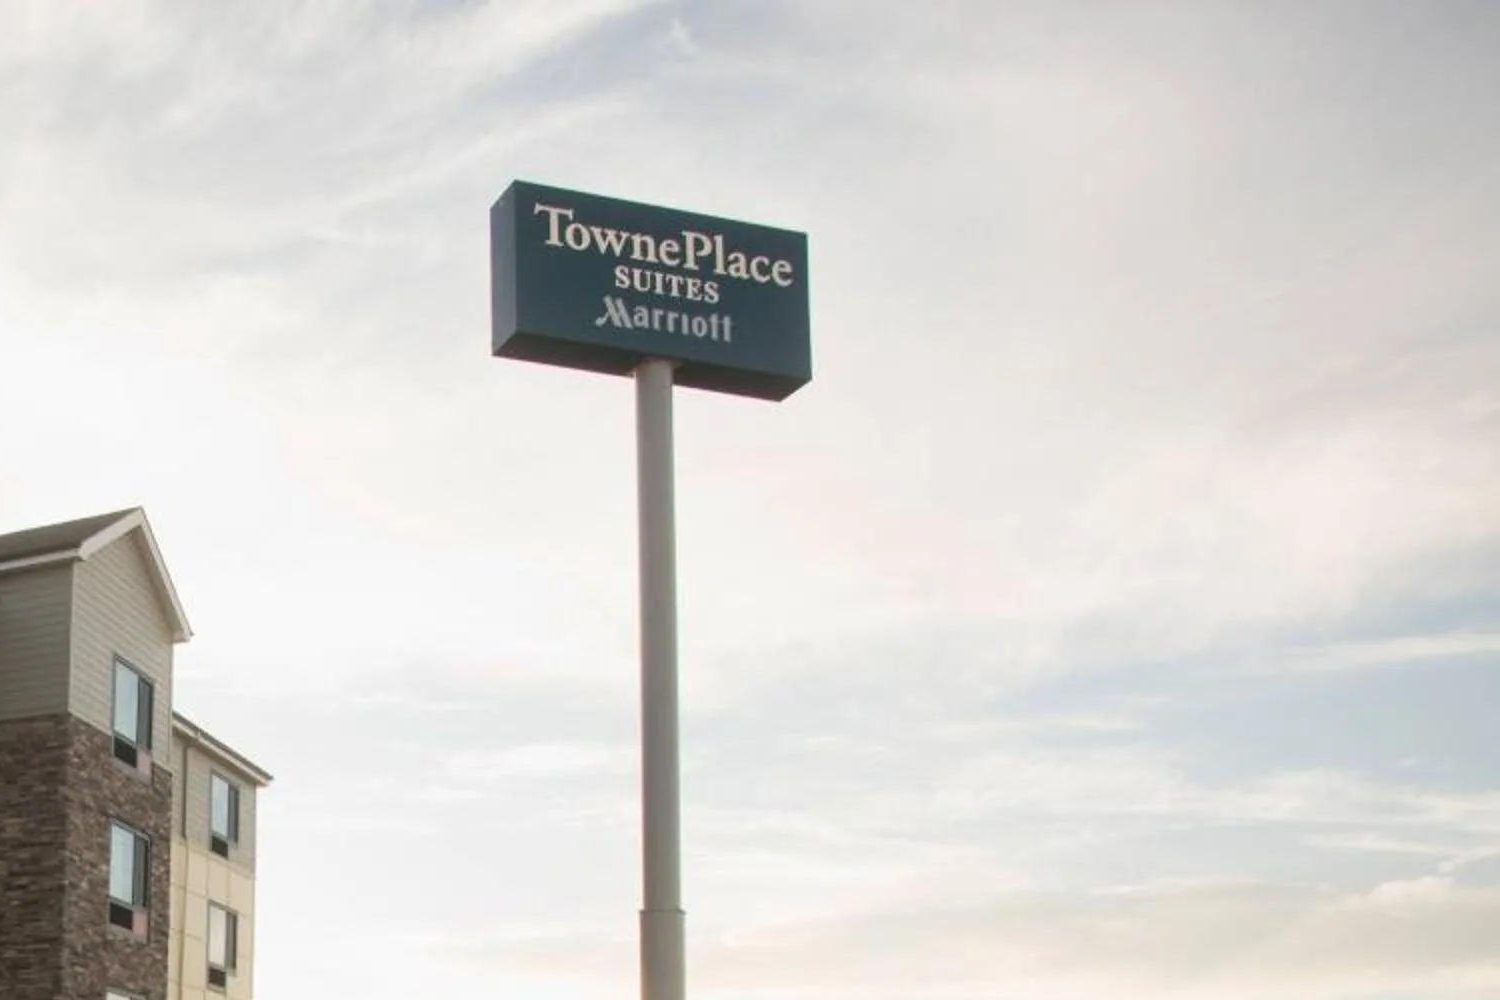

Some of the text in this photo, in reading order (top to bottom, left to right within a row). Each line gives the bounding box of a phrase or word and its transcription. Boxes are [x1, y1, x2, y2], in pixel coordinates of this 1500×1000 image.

[534, 202, 793, 287] TownePlace
[614, 265, 720, 304] SUITES
[595, 296, 733, 343] Marriott
